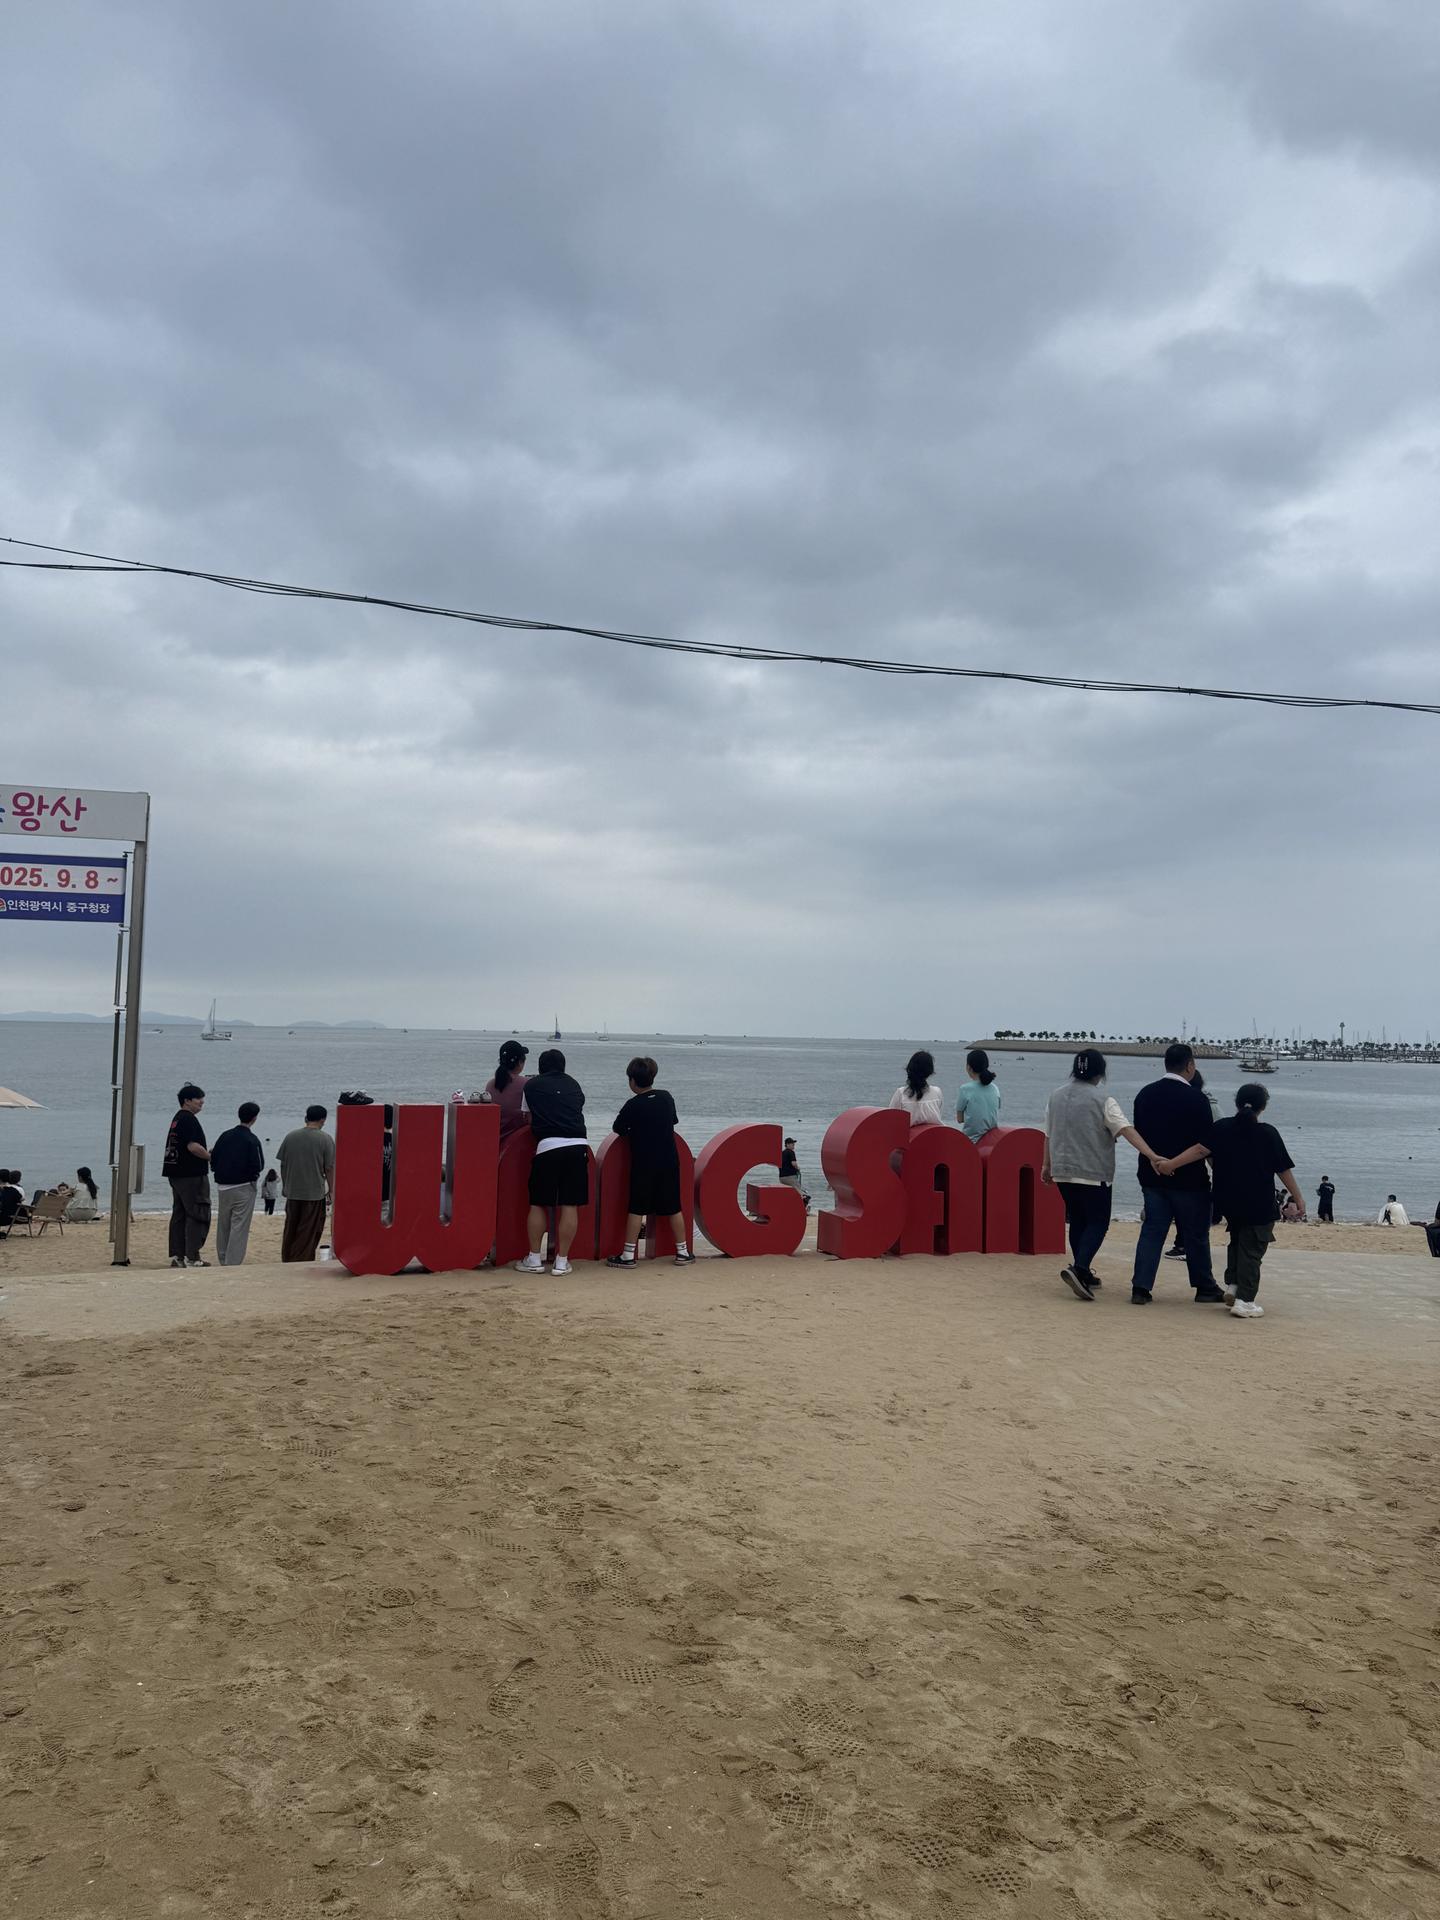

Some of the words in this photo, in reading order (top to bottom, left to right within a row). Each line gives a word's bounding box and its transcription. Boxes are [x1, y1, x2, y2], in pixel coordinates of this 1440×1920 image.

[12, 792, 88, 832] 왕산
[7, 899, 62, 912] 인천광역시
[66, 902, 110, 914] 중구청장
